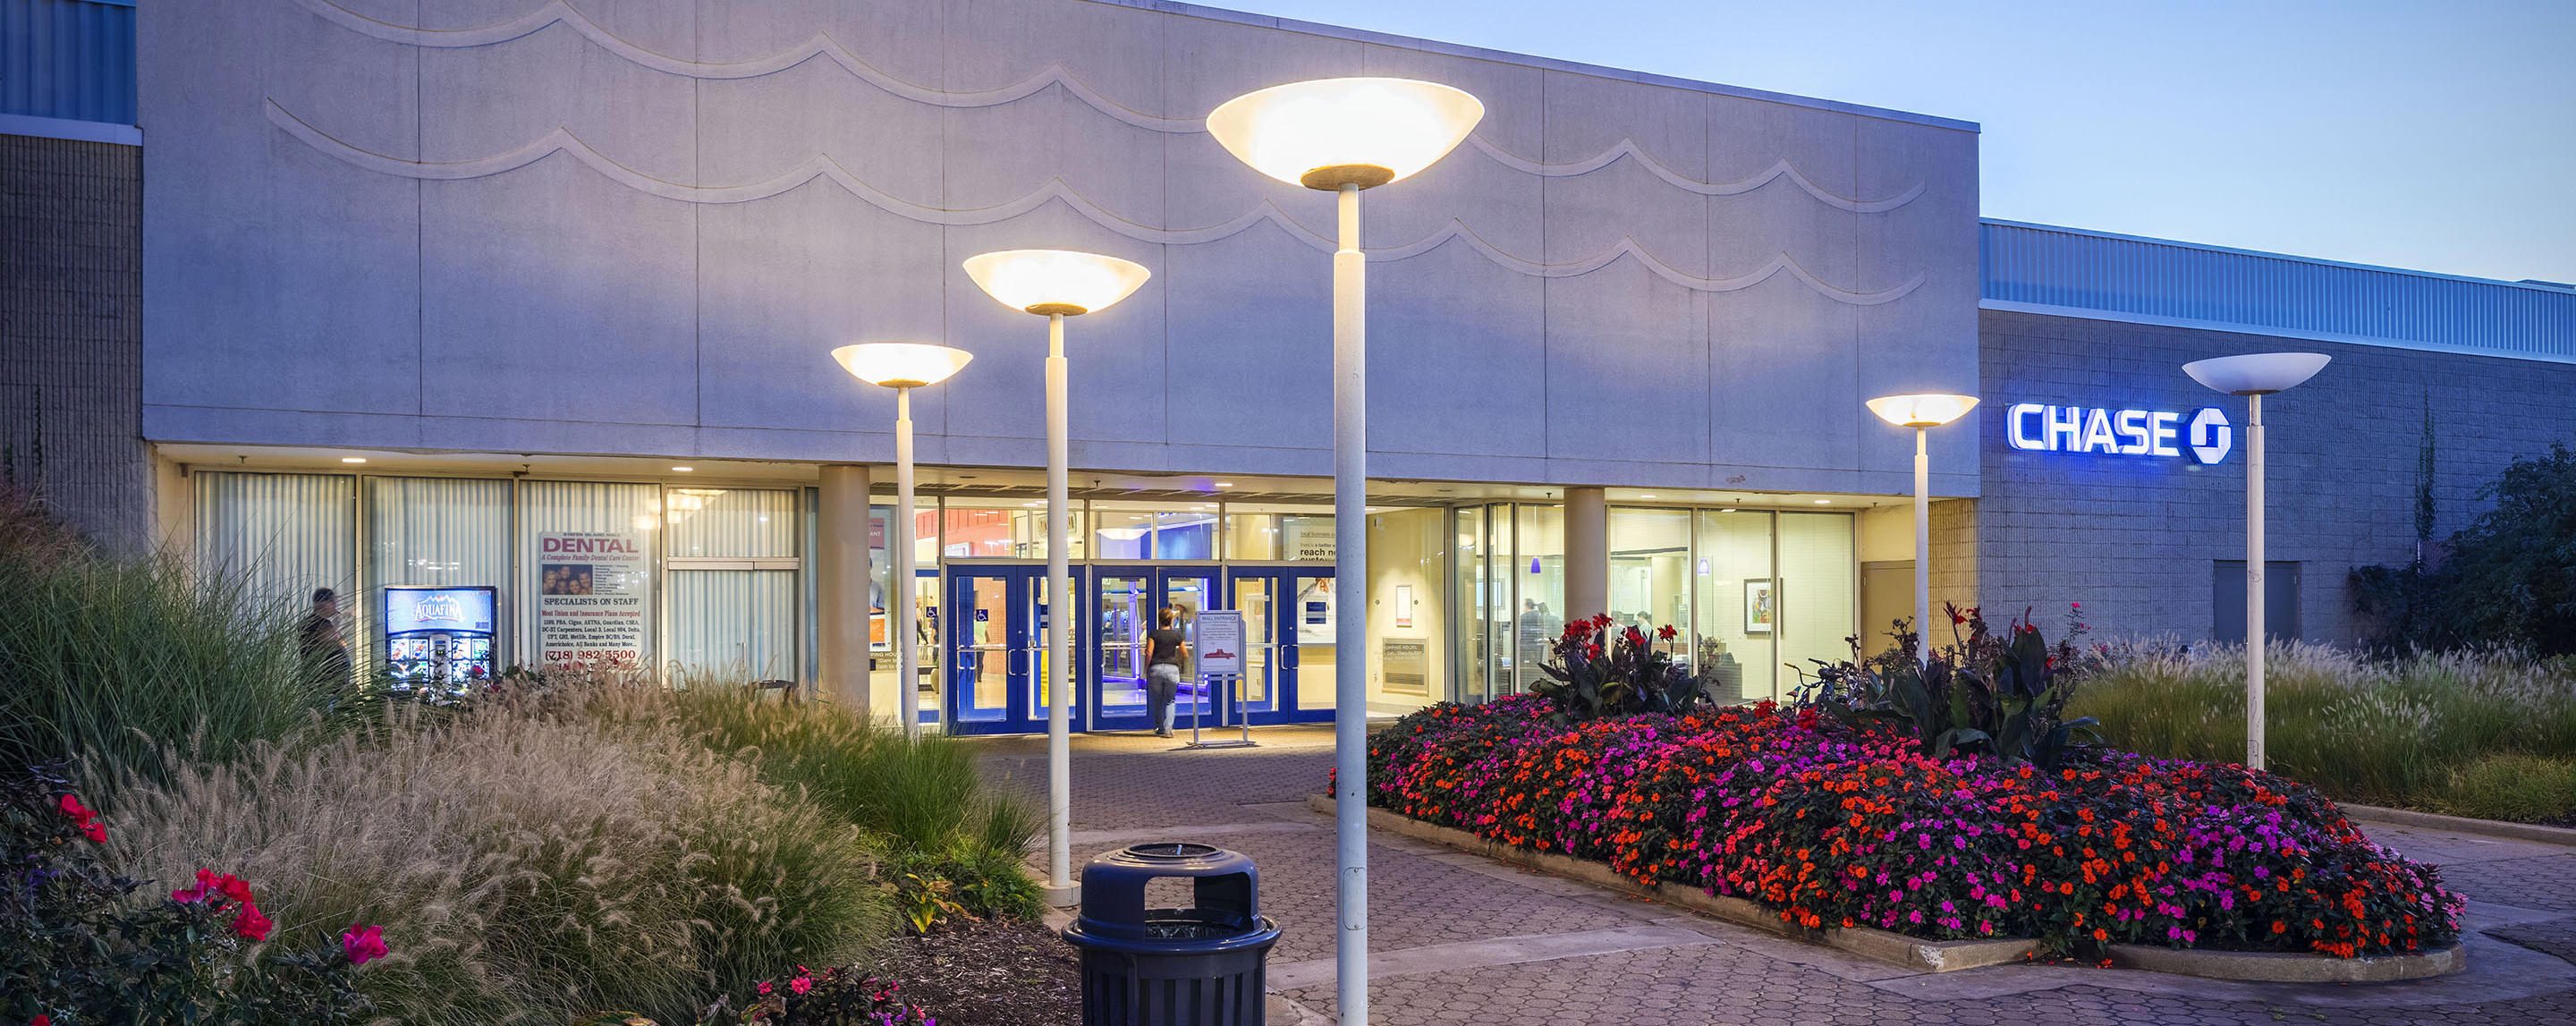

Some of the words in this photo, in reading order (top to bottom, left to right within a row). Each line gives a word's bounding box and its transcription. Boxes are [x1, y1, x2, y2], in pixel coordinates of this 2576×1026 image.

[2006, 403, 2181, 457] CHASE
[543, 538, 639, 553] DENTAL
[1301, 548, 1326, 556] reach
[544, 598, 597, 606] SPECIALISTS
[415, 601, 465, 623] AQUAFINA
[619, 610, 640, 618] Accepted
[545, 649, 573, 661] (718)
[577, 649, 636, 659] 9825500
